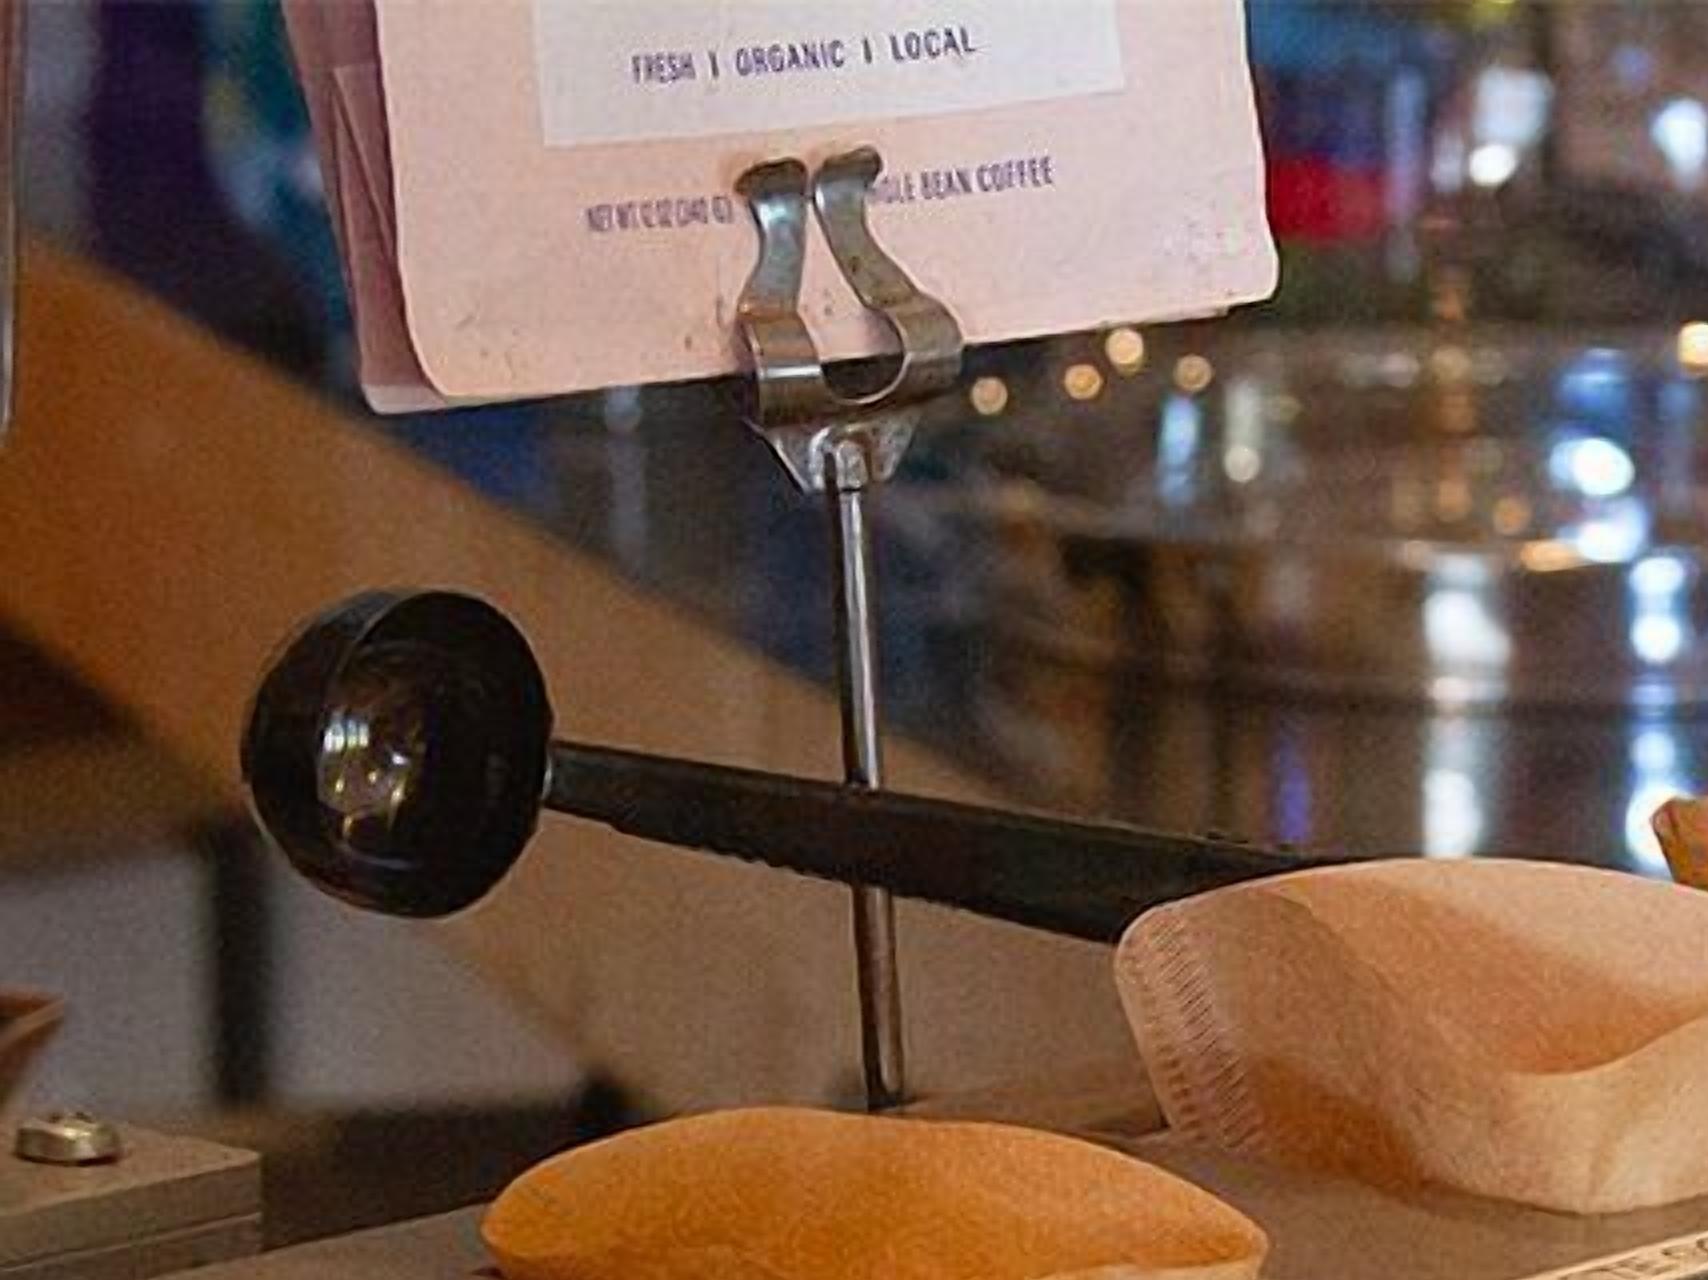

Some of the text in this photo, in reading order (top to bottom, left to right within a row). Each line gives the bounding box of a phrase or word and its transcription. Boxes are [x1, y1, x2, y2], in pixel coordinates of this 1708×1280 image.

[632, 54, 696, 84] FRESH
[735, 39, 844, 77] ORGANIC
[890, 27, 976, 64] LOCAL
[976, 156, 1052, 193] COFFEE
